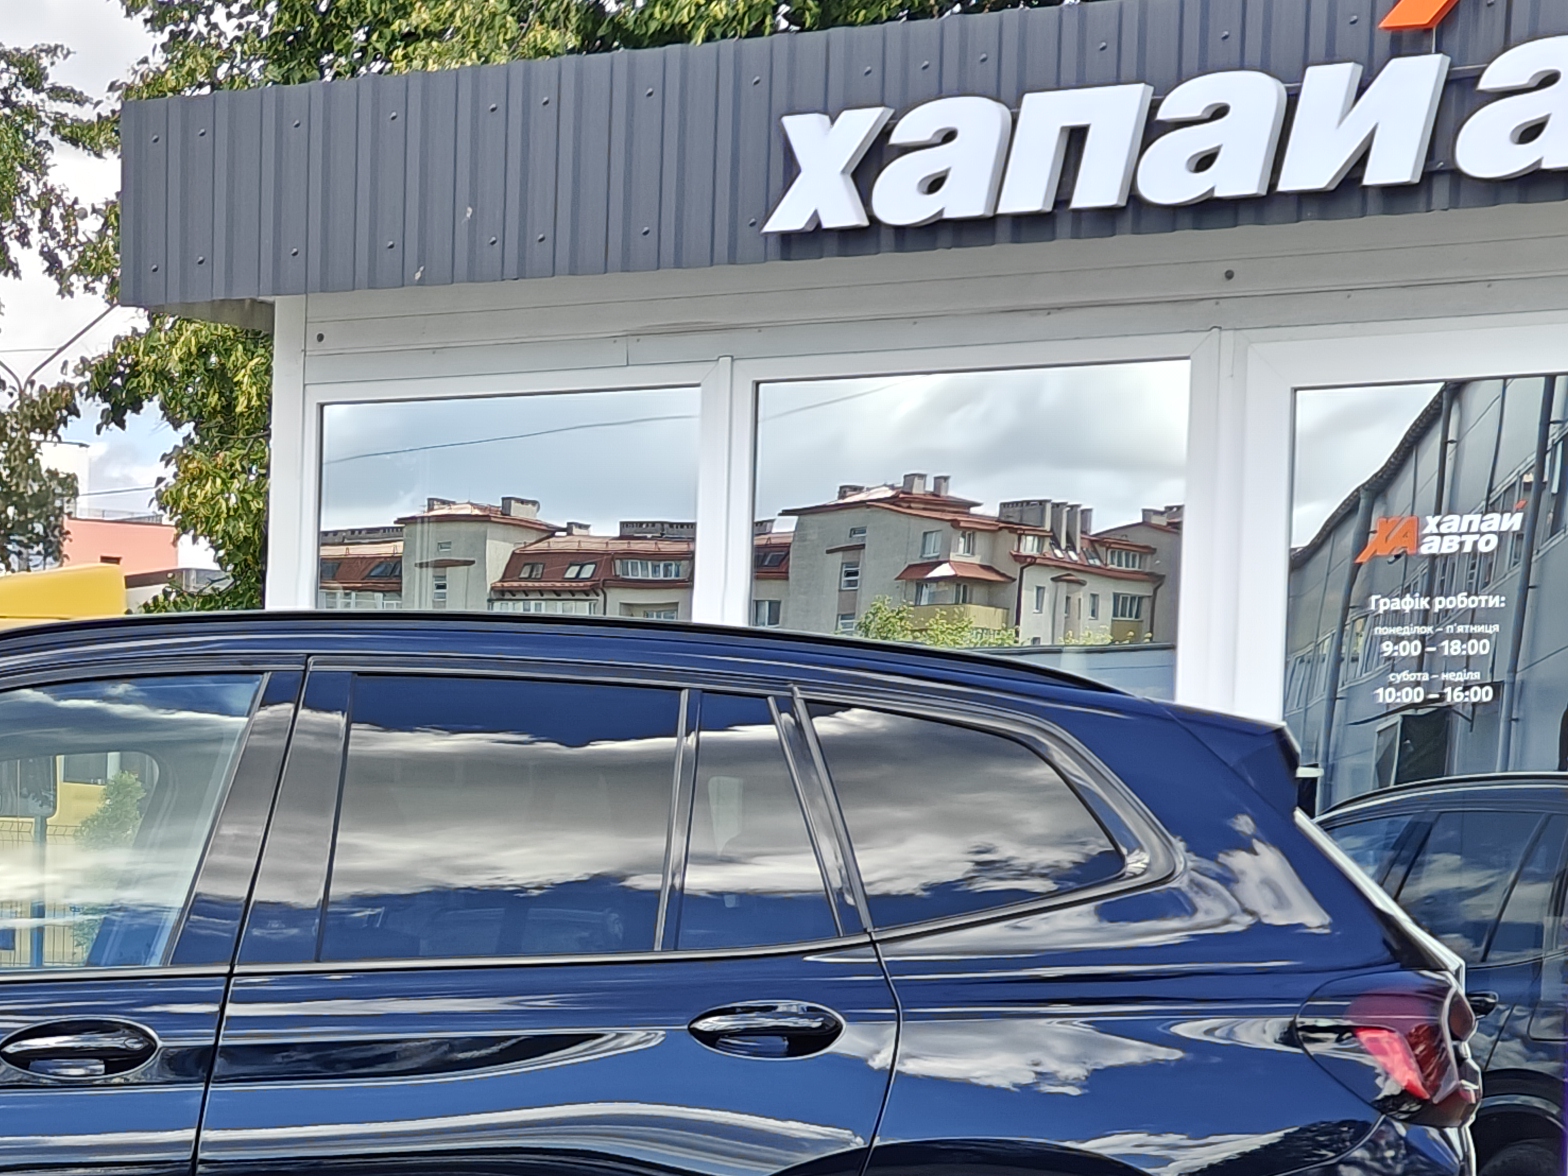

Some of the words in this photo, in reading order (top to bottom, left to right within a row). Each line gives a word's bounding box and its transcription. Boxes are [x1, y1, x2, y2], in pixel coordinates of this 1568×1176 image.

[1422, 500, 1528, 534] хапай
[1420, 533, 1499, 555] авто
[1369, 593, 1430, 613] Графік
[1434, 592, 1506, 612] роботи:
[1374, 624, 1434, 636] понеділок
[1381, 641, 1422, 657] 9:00
[1442, 639, 1490, 656] 18:00
[1389, 670, 1429, 683] субота
[1442, 670, 1481, 682] неділя
[1374, 687, 1424, 703] 10:00
[1444, 686, 1494, 702] 16:00
